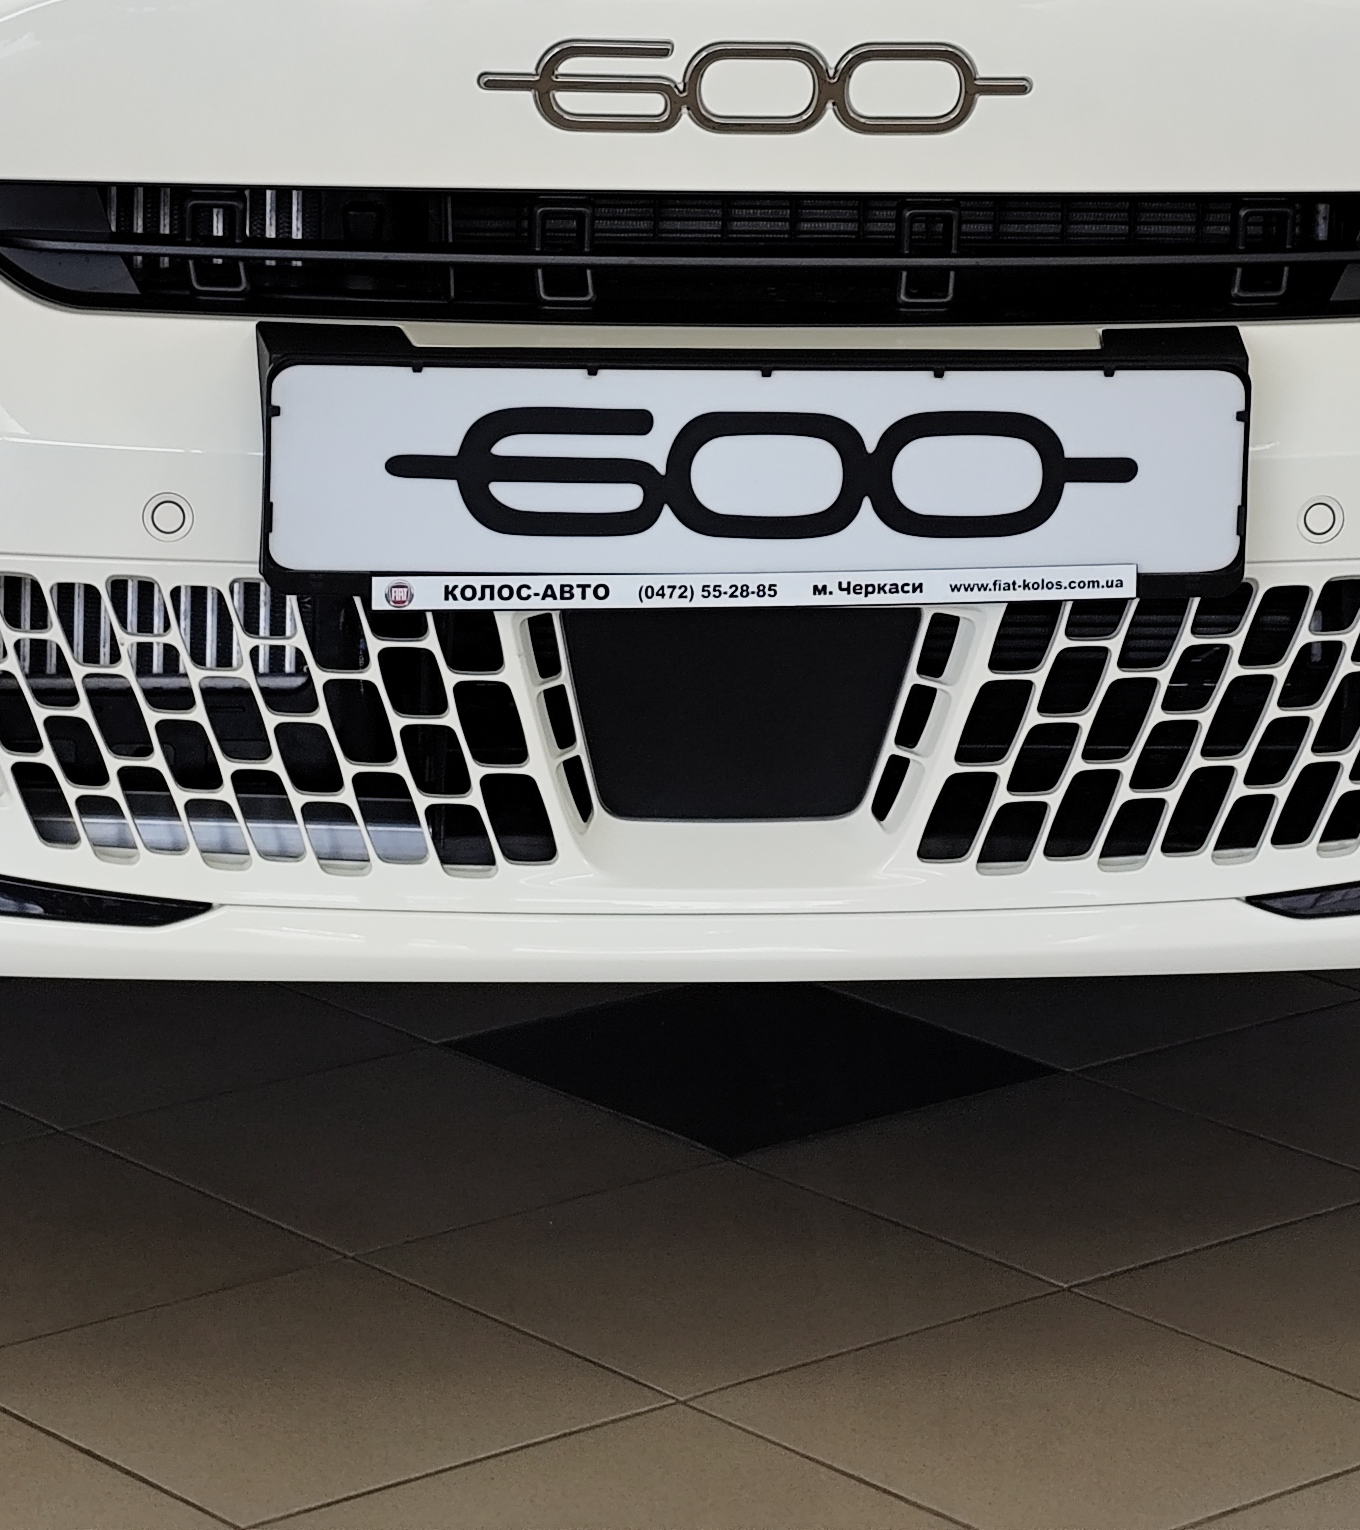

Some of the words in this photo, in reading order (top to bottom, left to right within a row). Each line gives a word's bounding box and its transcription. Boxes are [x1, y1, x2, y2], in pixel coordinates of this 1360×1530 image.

[477, 38, 1033, 135] 600
[385, 407, 1139, 539] 600
[443, 583, 610, 602] КОЛОС-АВТО
[638, 584, 695, 602] (0472)
[701, 583, 777, 598] 55-28-85
[812, 583, 834, 596] м.
[837, 580, 924, 598] Черкаси
[949, 577, 1124, 593] www.fiat-kolos.com.ua
